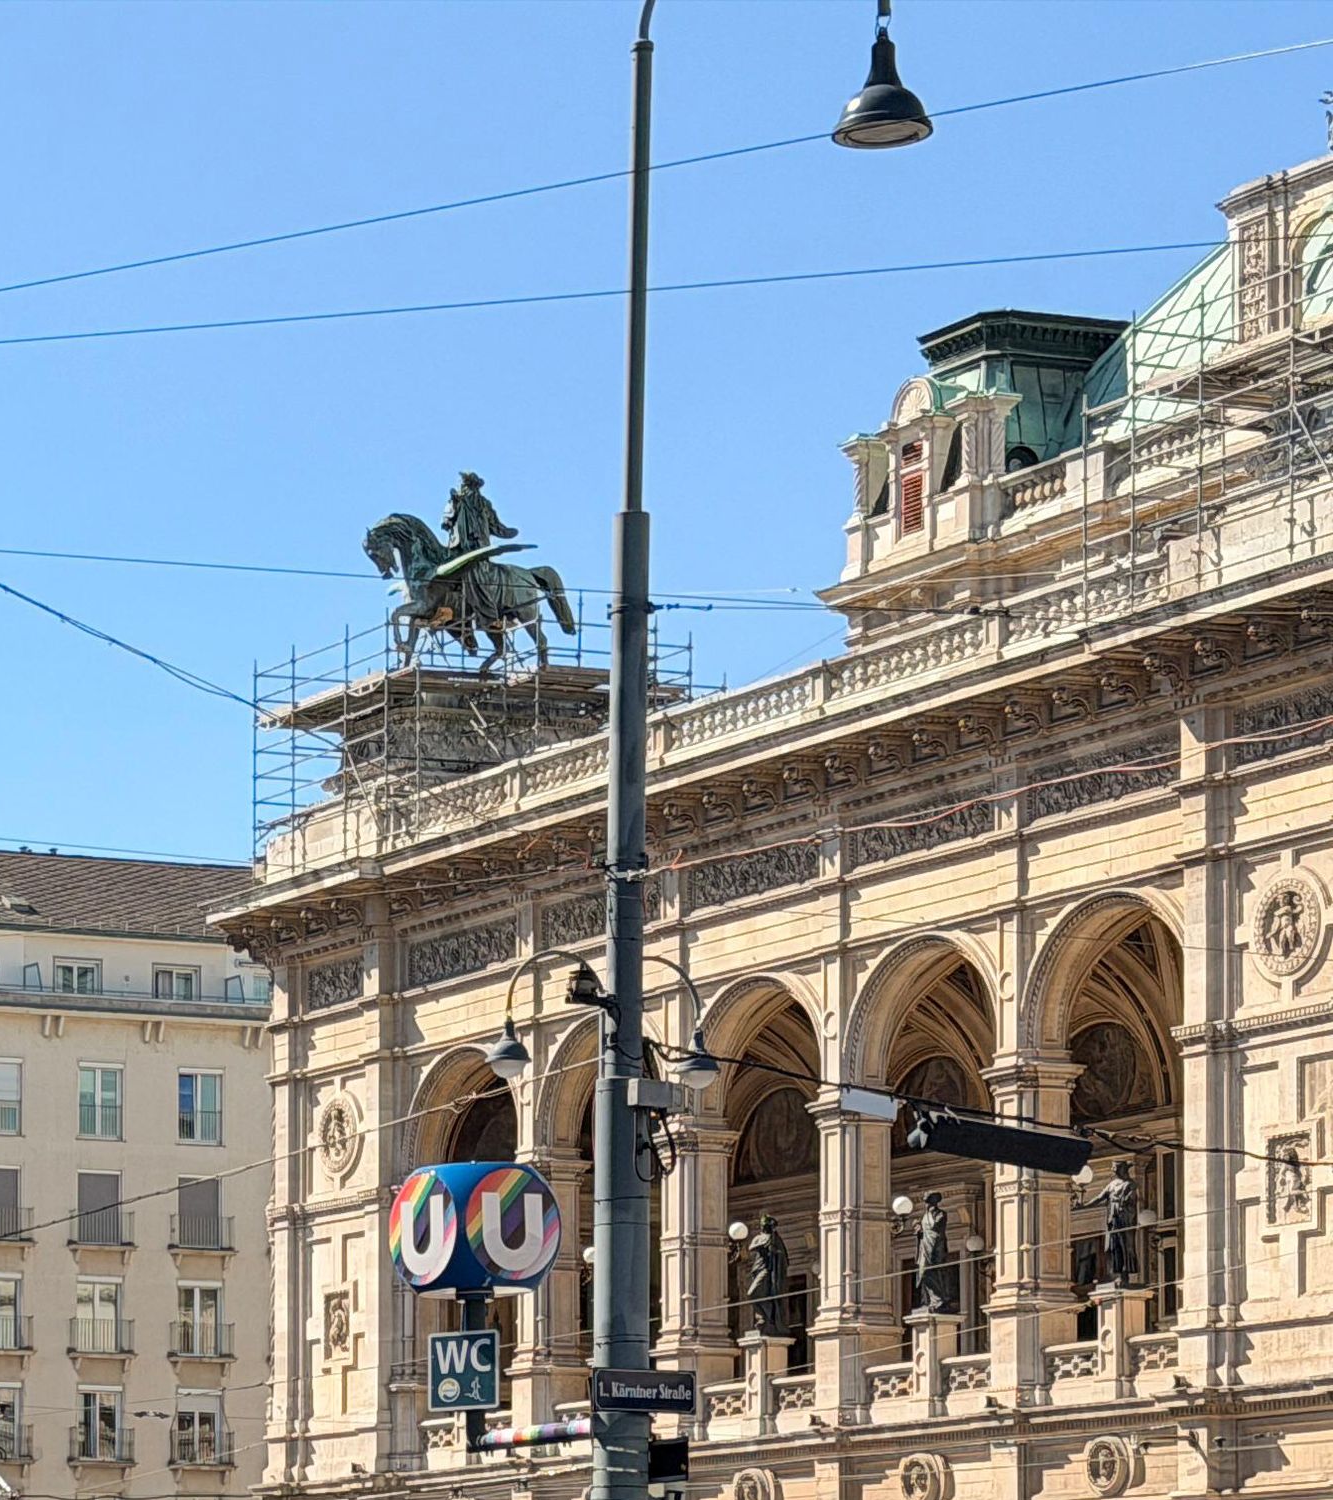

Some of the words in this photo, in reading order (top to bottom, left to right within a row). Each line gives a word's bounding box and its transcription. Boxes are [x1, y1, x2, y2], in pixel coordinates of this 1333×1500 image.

[400, 1193, 445, 1277] U
[482, 1191, 543, 1272] U
[436, 1337, 492, 1375] WC
[611, 1380, 657, 1400] Kärntner
[657, 1381, 692, 1402] Straße
